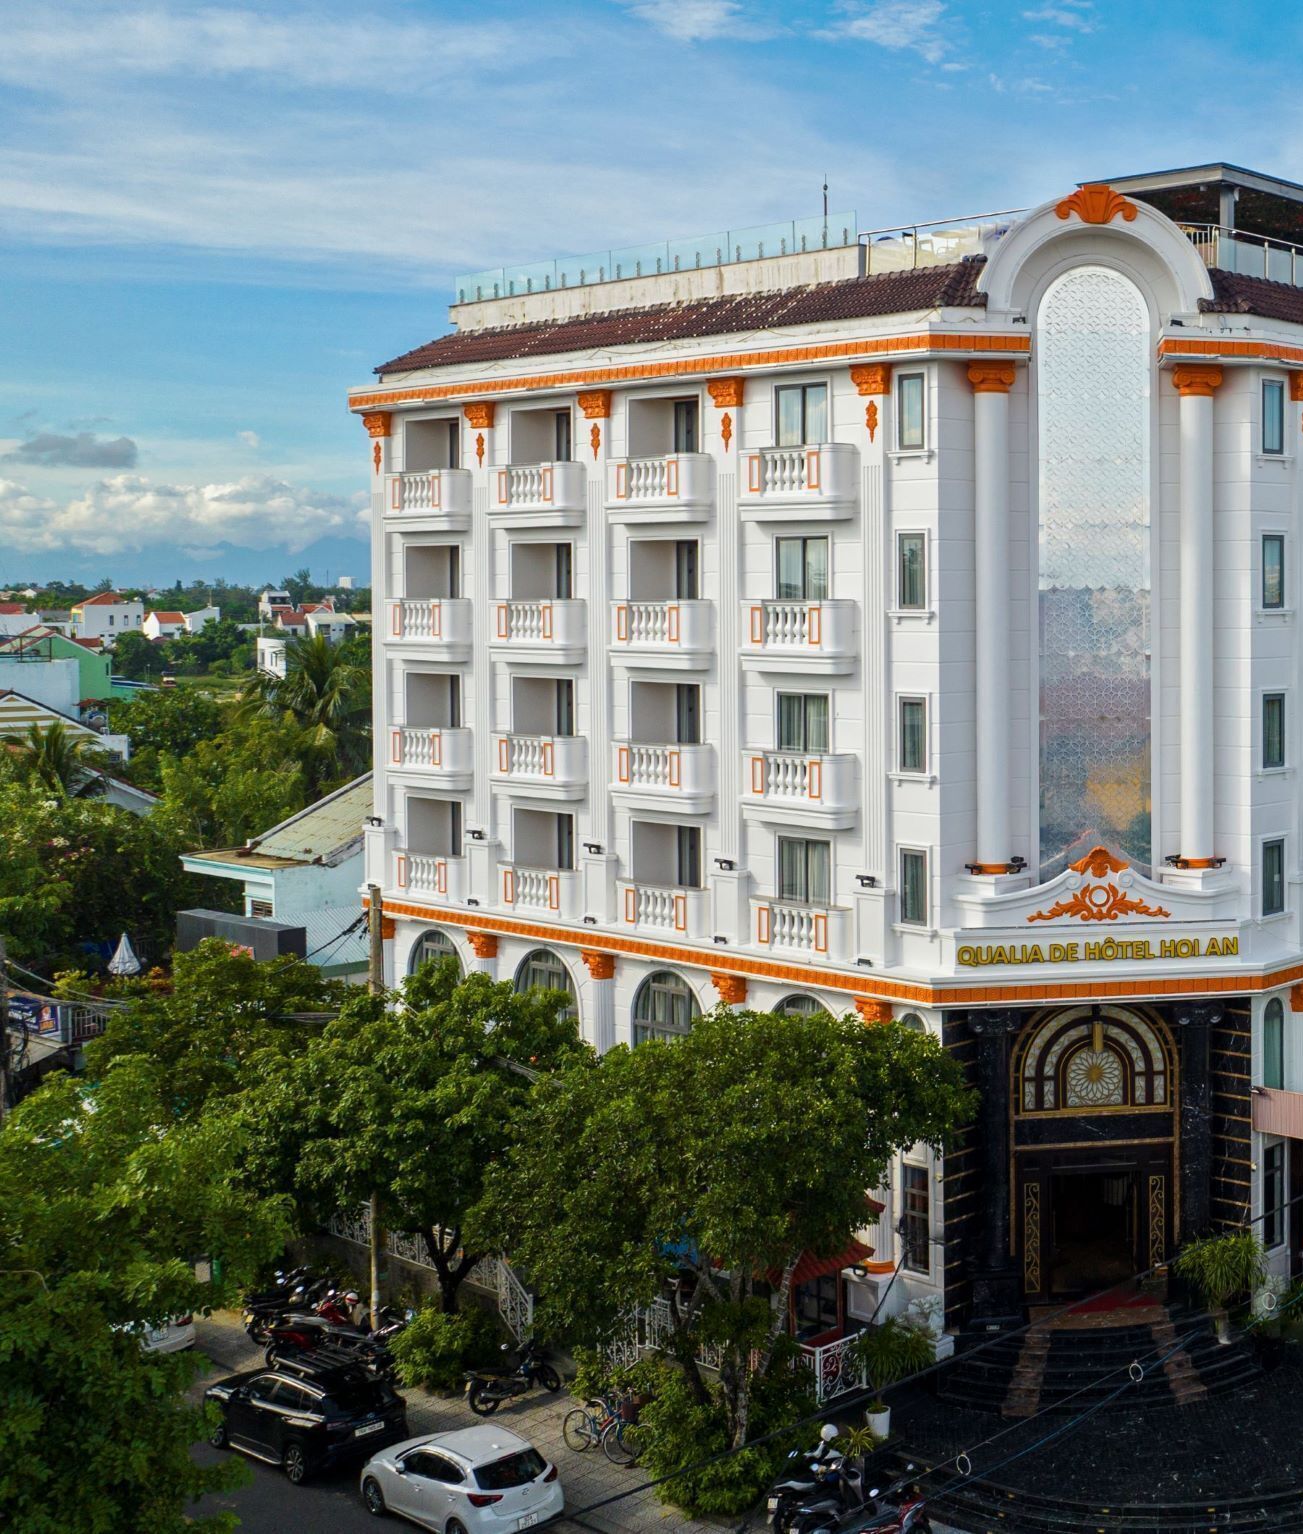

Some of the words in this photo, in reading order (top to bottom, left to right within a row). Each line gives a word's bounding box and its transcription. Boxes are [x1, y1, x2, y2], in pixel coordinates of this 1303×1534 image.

[957, 943, 1044, 966] QUALIA
[1049, 942, 1079, 962] DE
[1084, 936, 1154, 961] HÔTEL
[1160, 938, 1199, 958] HOI
[1205, 936, 1239, 956] AN
